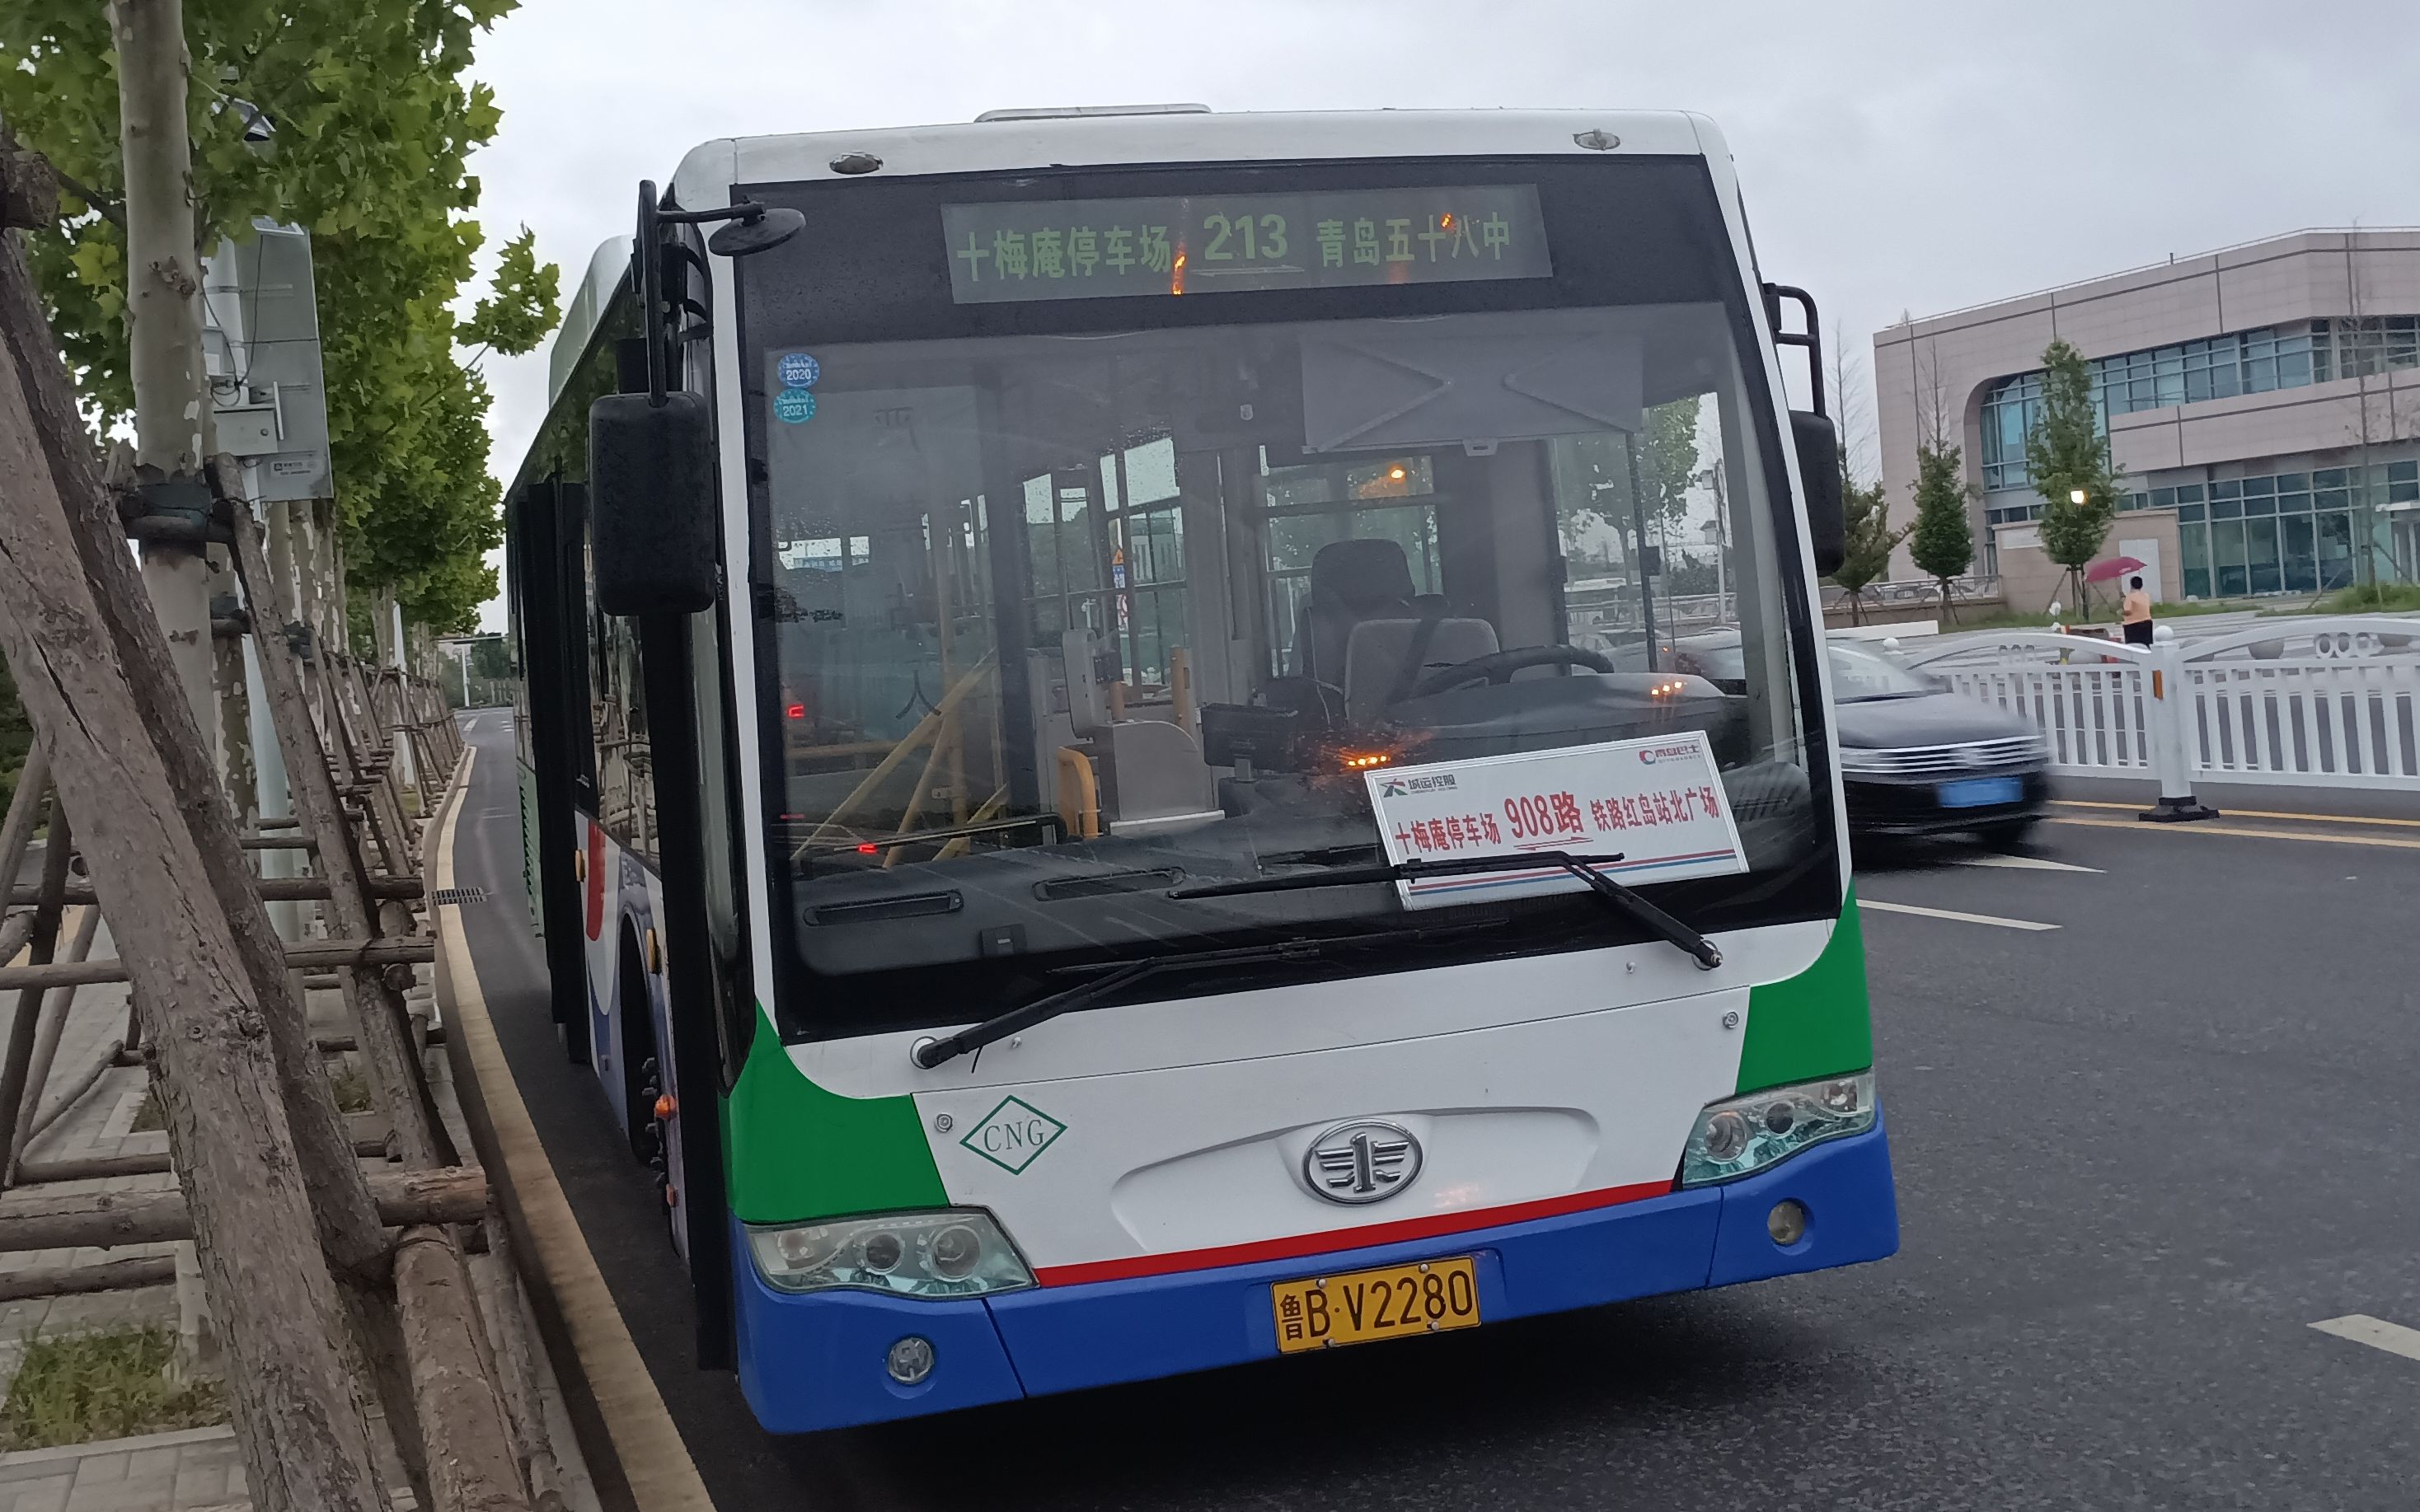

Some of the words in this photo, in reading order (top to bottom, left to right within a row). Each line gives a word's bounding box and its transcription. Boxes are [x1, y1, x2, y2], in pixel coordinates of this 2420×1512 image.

[956, 224, 1172, 282] 十梅庵停车场
[1203, 212, 1287, 261] 213
[1316, 212, 1510, 268] 青岛五十八中
[786, 368, 812, 381] 2020
[783, 404, 808, 417] 2021
[1408, 775, 1457, 789] 城运控股
[1395, 812, 1503, 854] 十梅庵停车场
[1504, 791, 1584, 839] 908路
[1590, 786, 1720, 832] 铁路红岛站北广场
[983, 1119, 1045, 1153] CNG
